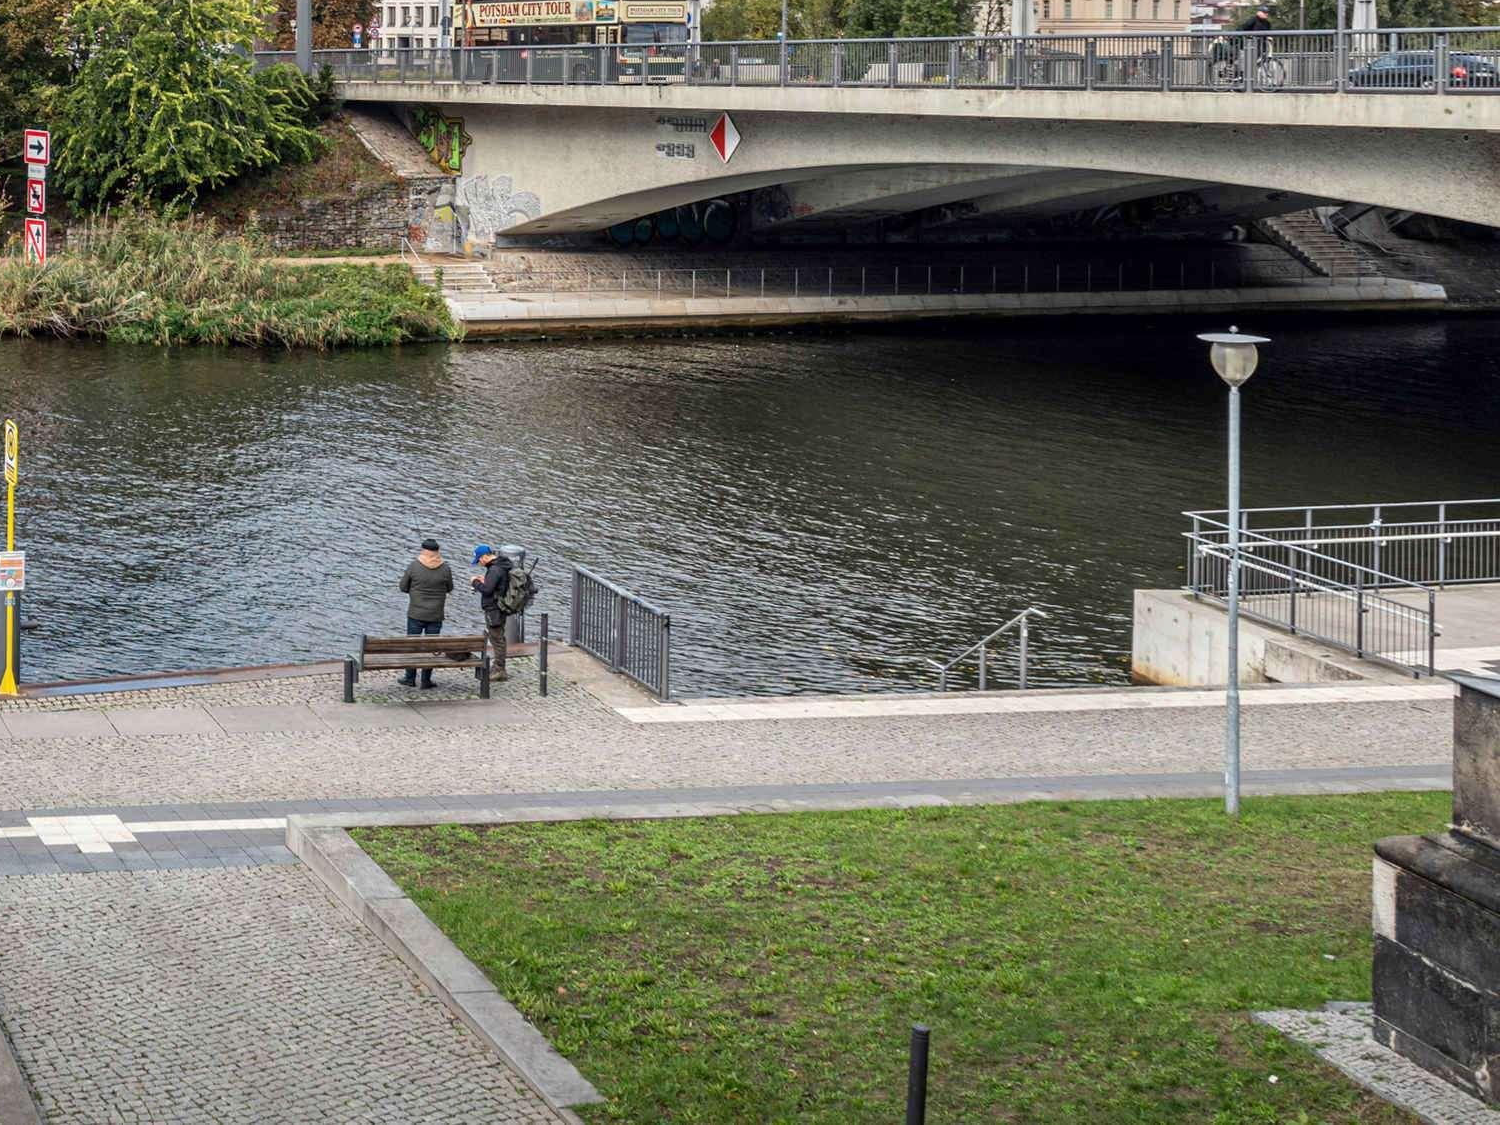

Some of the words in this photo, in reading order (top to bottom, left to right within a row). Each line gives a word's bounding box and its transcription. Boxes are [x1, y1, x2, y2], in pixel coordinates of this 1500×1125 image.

[479, 4, 520, 17] POTSDAM
[522, 3, 544, 16] CITY
[546, 1, 571, 15] TOUR
